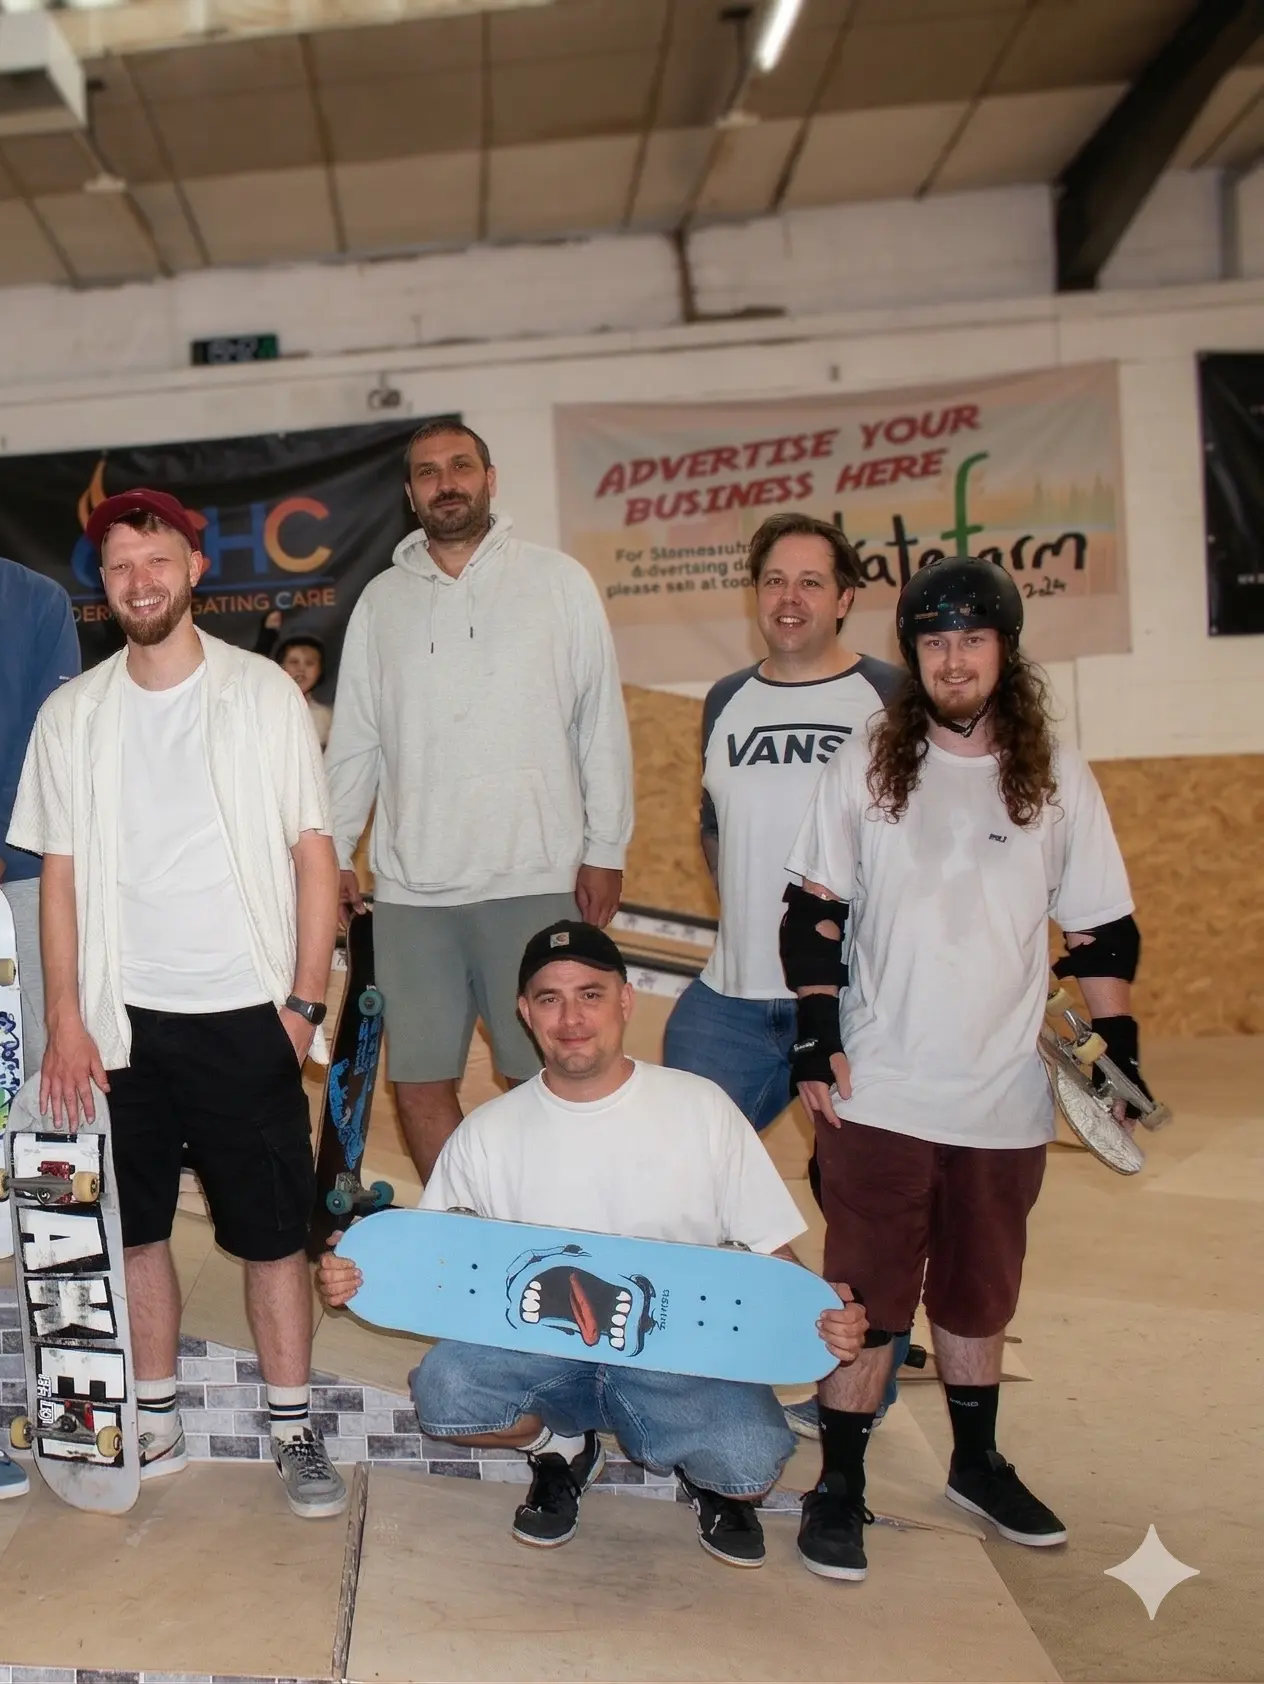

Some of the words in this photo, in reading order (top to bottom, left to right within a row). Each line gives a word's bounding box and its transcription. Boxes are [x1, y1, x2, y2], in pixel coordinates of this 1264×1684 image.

[595, 428, 840, 498] ADVERTISE
[859, 403, 983, 451] YOUR
[623, 472, 814, 527] BUSINESS
[834, 448, 948, 494] HERE
[274, 588, 337, 610] CARE
[727, 722, 853, 768] VANS
